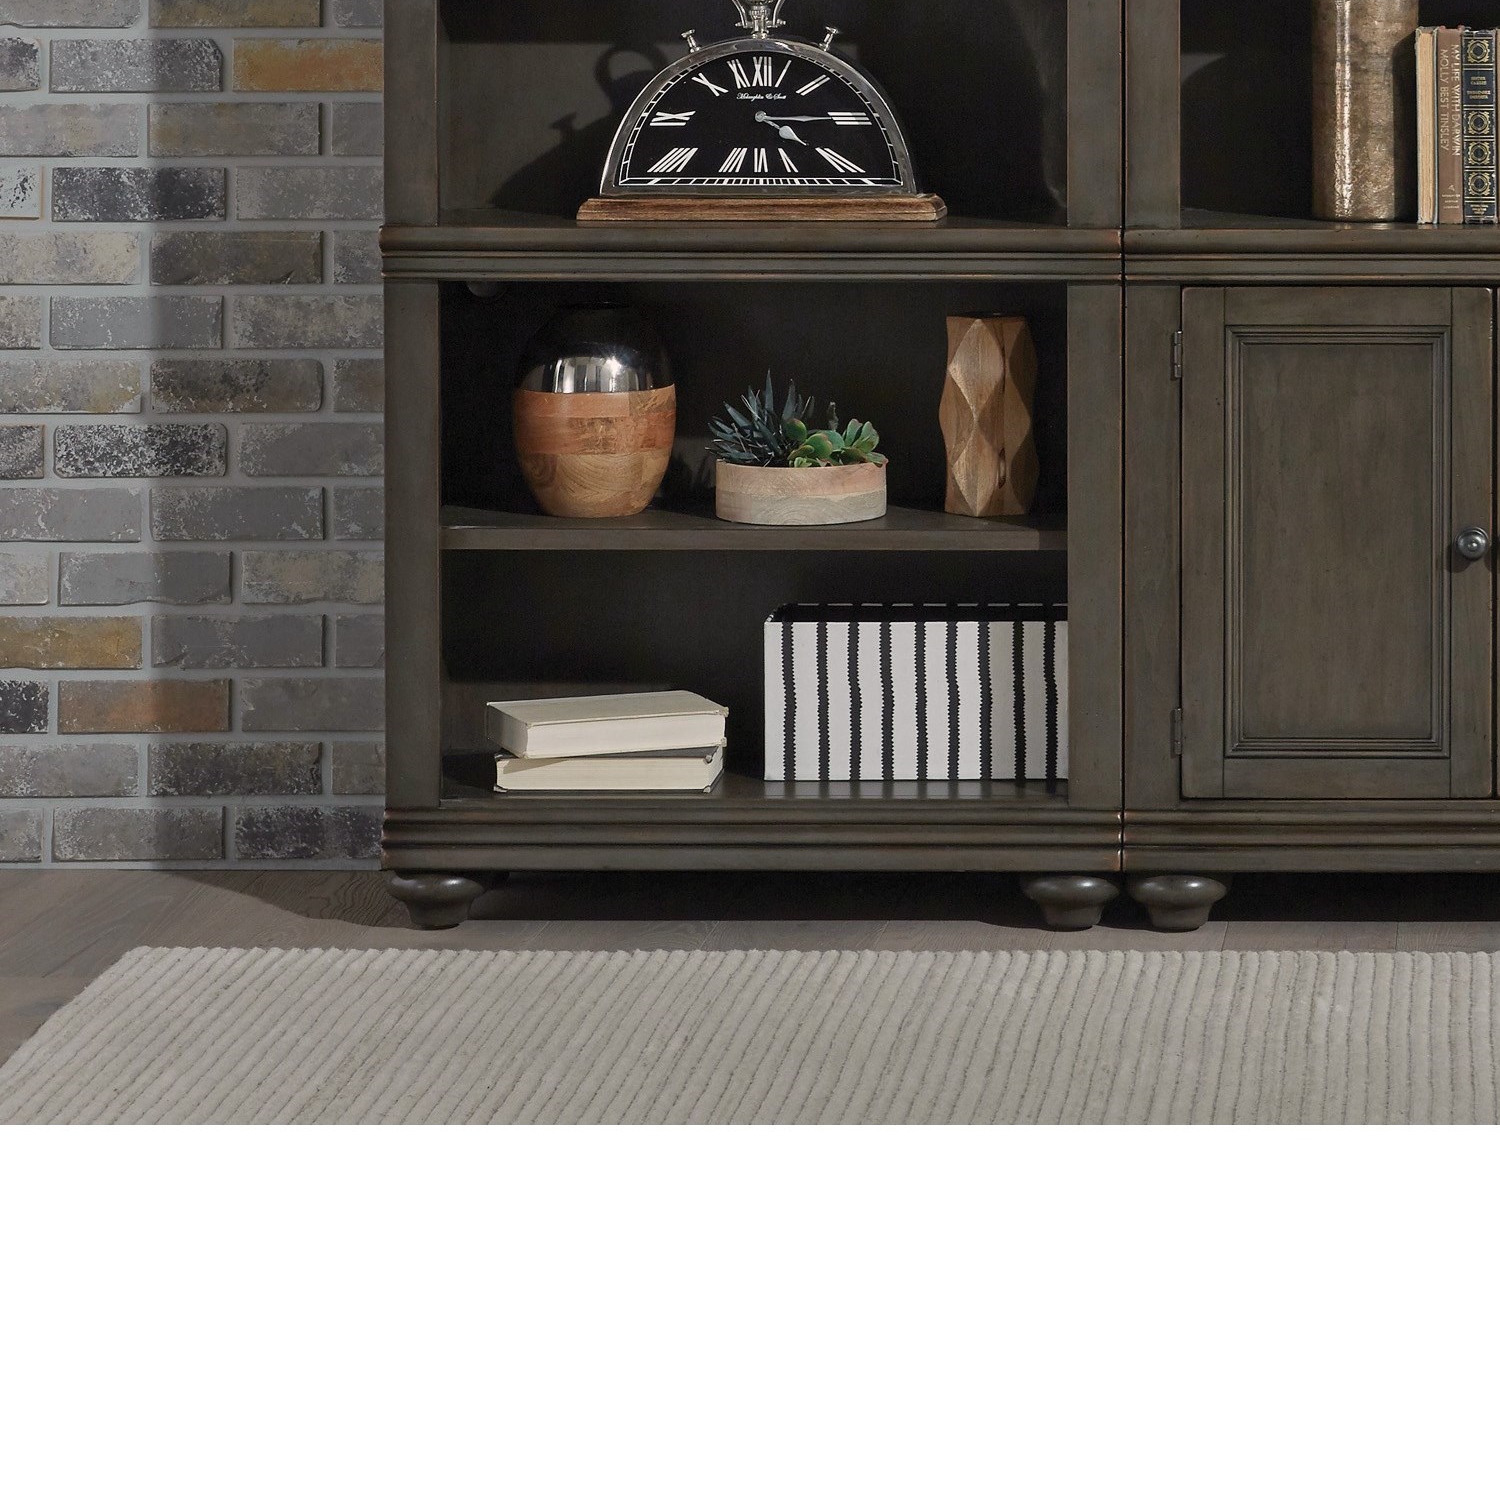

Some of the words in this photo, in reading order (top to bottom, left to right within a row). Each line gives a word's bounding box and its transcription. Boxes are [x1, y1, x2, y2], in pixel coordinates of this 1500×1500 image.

[1440, 49, 1449, 83] MOLLY
[1451, 44, 1460, 60] MY
[691, 72, 730, 97] X
[752, 56, 772, 87] XII
[1451, 62, 1460, 81] LIFE
[1440, 87, 1449, 109] BEST
[1452, 84, 1461, 112] WITH
[1440, 113, 1449, 151] TINSLEY
[1452, 114, 1461, 156] DARWIN
